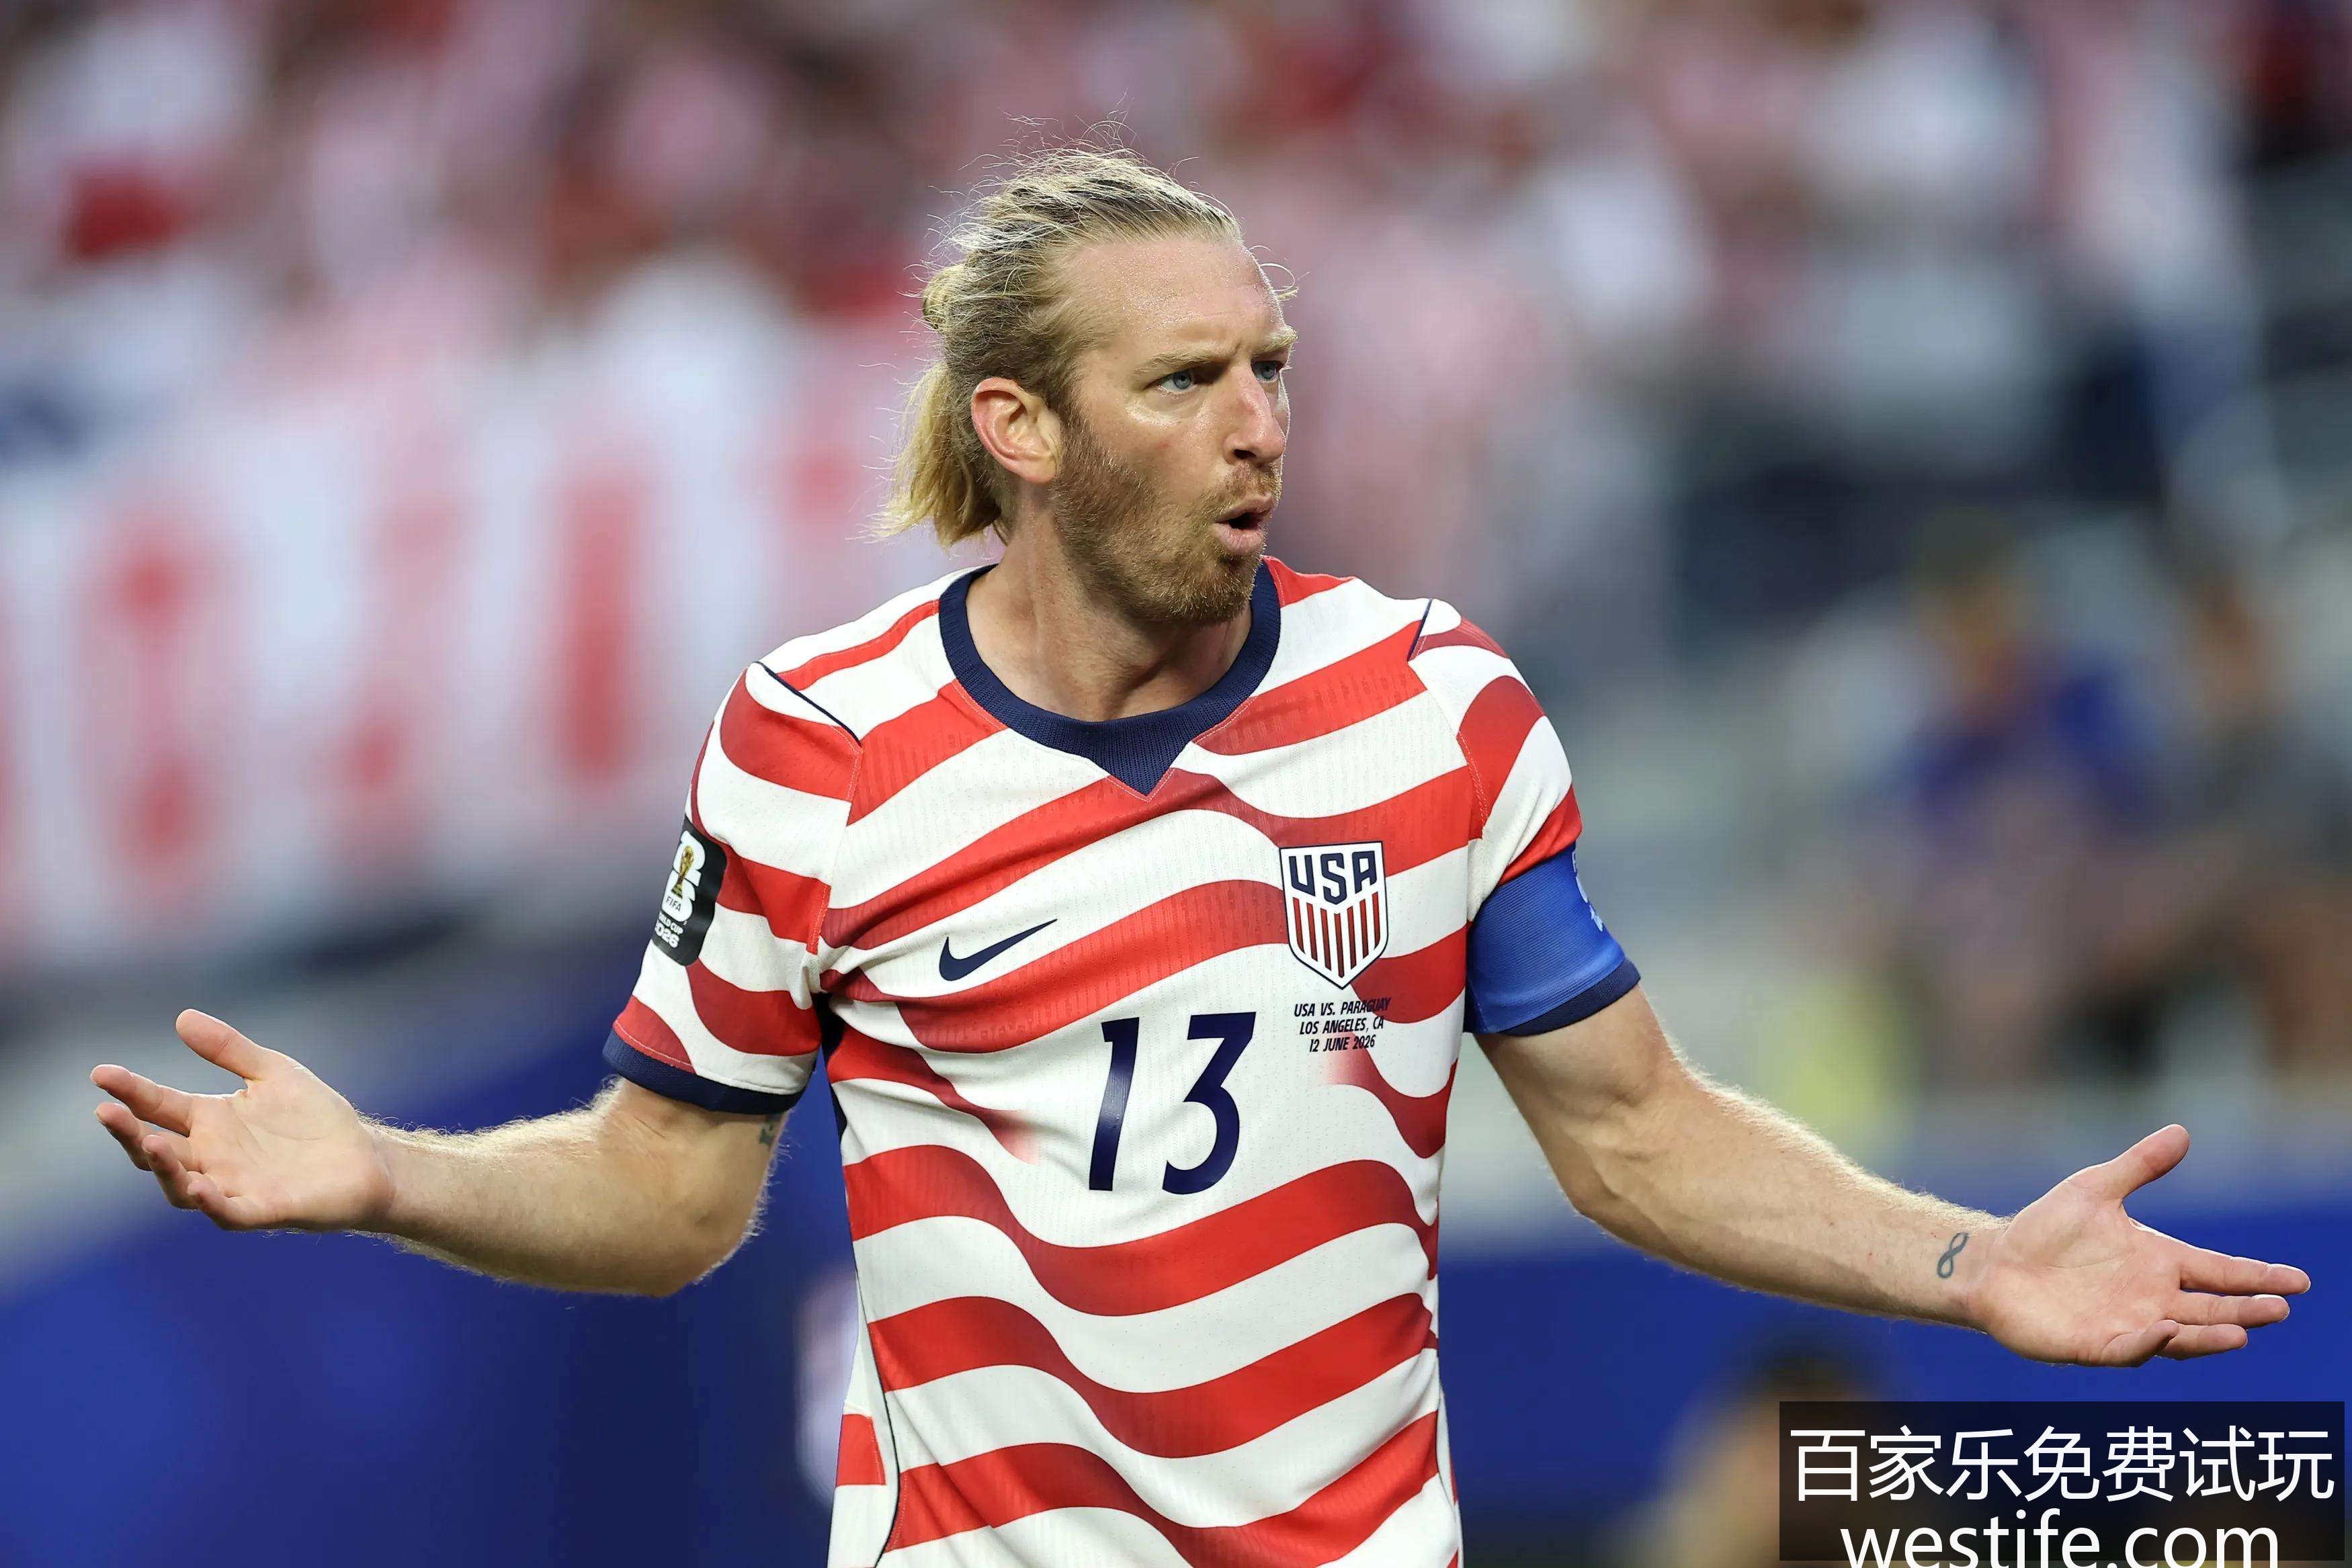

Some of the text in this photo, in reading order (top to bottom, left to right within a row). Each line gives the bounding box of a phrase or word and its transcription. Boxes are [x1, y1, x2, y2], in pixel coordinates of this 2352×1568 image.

[1288, 850, 1378, 905] USA
[665, 896, 681, 912] FIFA
[655, 919, 680, 949] 026
[670, 922, 684, 935] CUP
[1294, 997, 1392, 1017] USA VS. PARAGUAY
[1300, 1016, 1384, 1035] LOS ANGELES, CA
[1309, 1035, 1376, 1053] 12 JUNE 2026
[1089, 1011, 1257, 1195] 13
